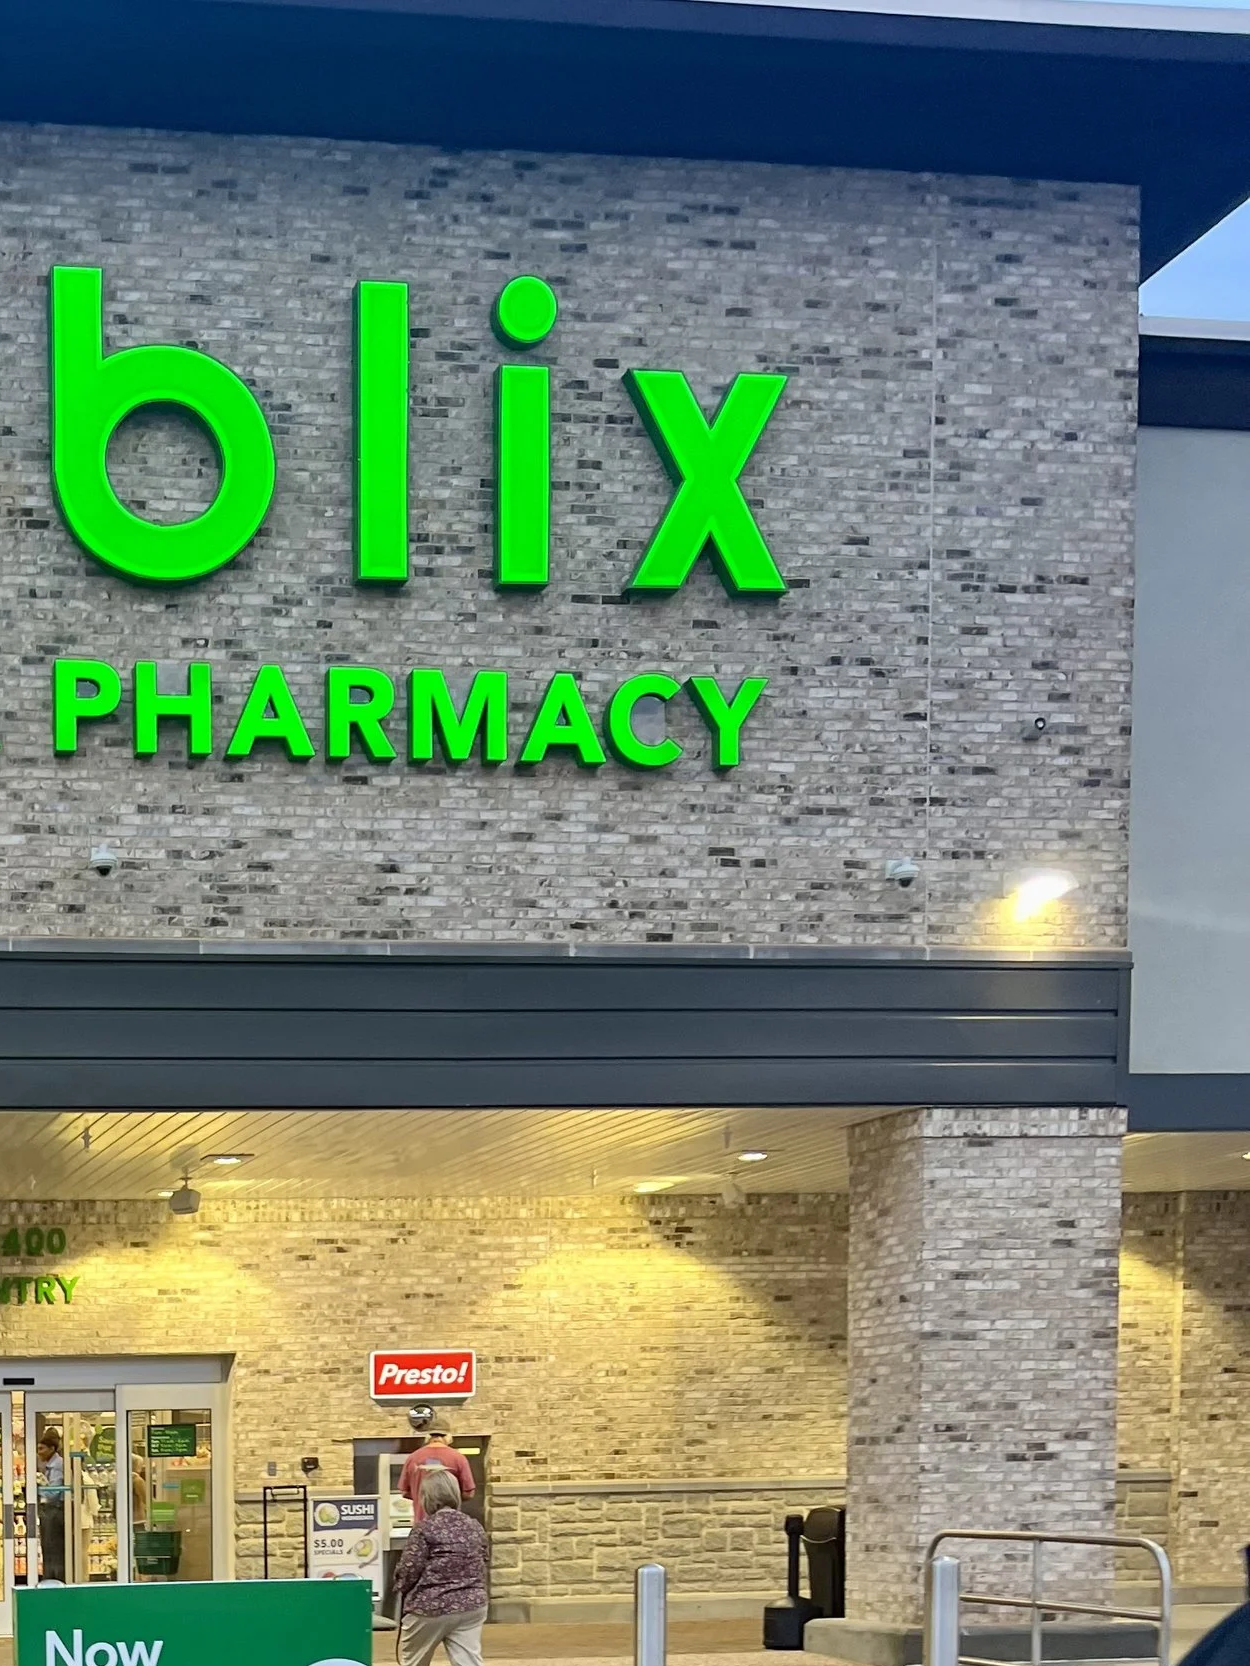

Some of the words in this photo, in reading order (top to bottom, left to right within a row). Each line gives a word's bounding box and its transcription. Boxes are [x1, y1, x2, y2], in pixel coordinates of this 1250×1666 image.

[52, 658, 769, 771] PHARMACY
[378, 1361, 469, 1386] Presto!
[341, 1504, 375, 1516] SUSHI
[313, 1539, 344, 1549] $5.00
